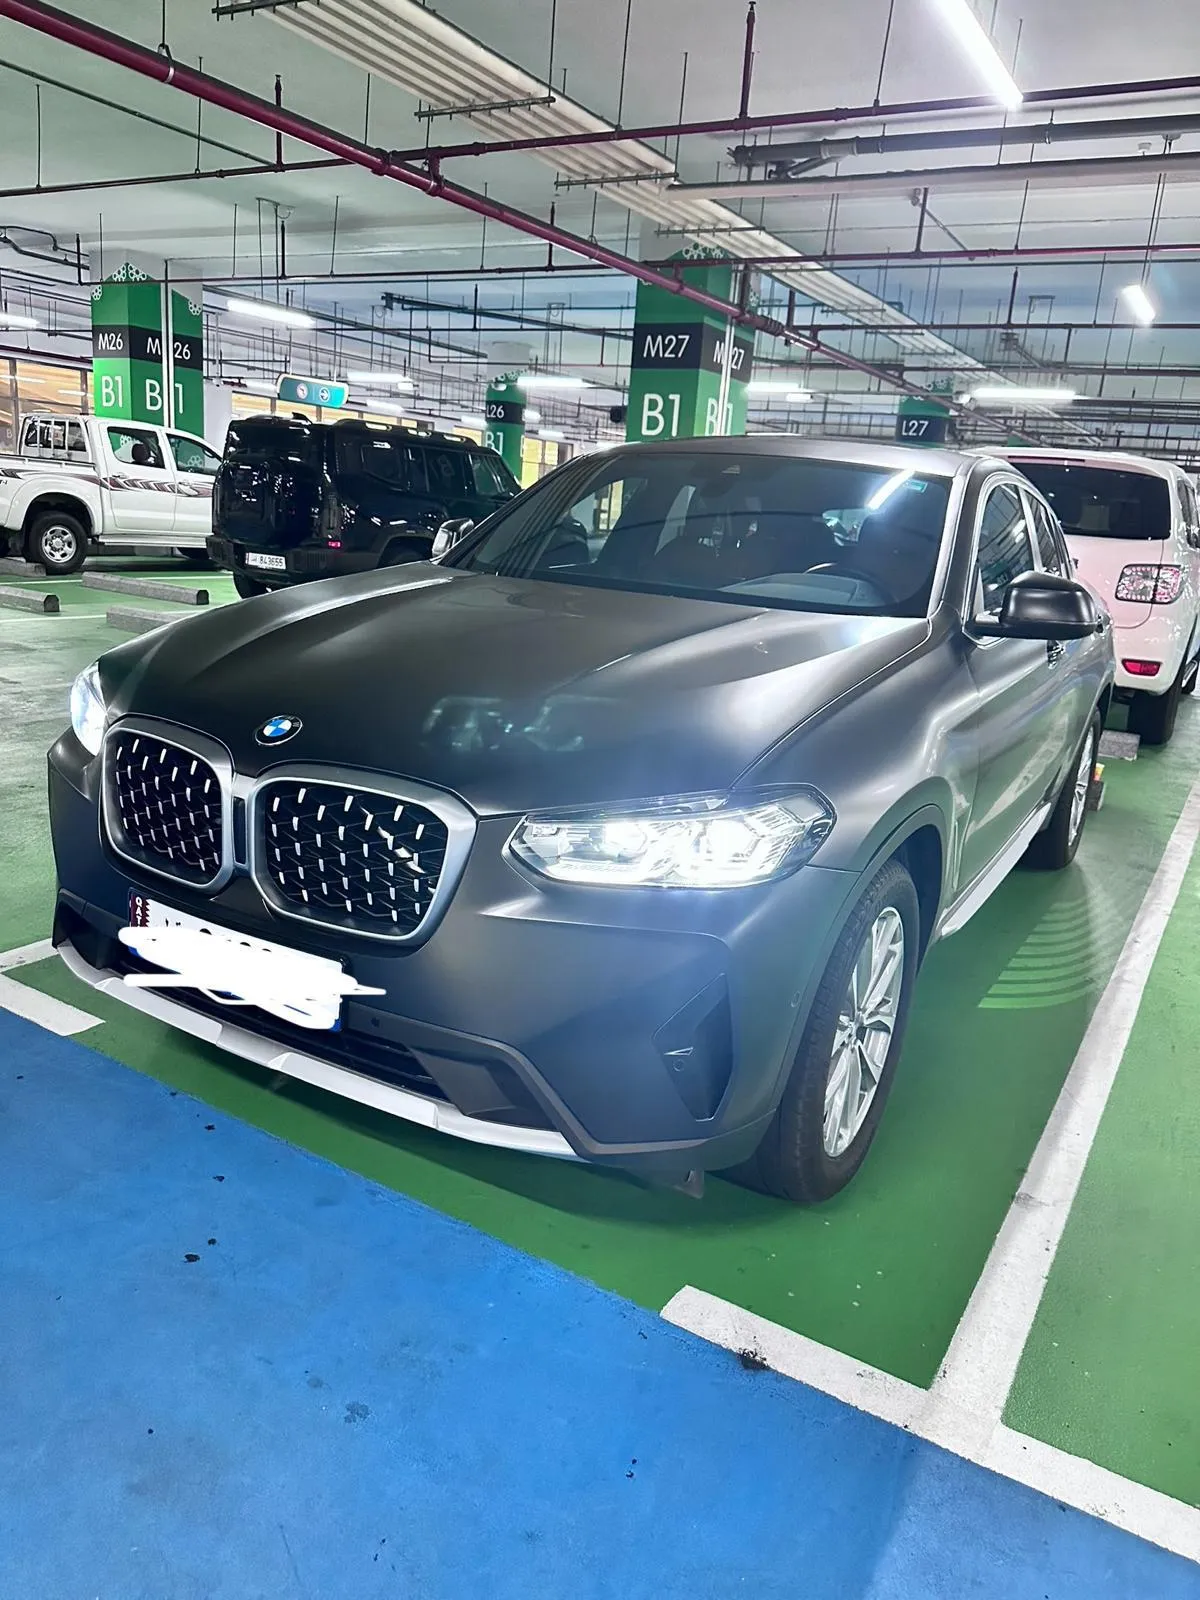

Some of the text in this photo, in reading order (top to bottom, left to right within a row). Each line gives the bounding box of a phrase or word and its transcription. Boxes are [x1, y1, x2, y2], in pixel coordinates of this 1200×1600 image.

[98, 332, 124, 351] M26
[146, 336, 191, 360] M26
[643, 334, 690, 358] M27
[713, 340, 745, 371] M27
[101, 375, 123, 408] B1
[145, 378, 184, 414] B1
[486, 404, 505, 418] L26
[641, 393, 681, 437] B1
[704, 397, 734, 437] B1
[901, 419, 929, 436] L27
[135, 896, 143, 927] QAT
